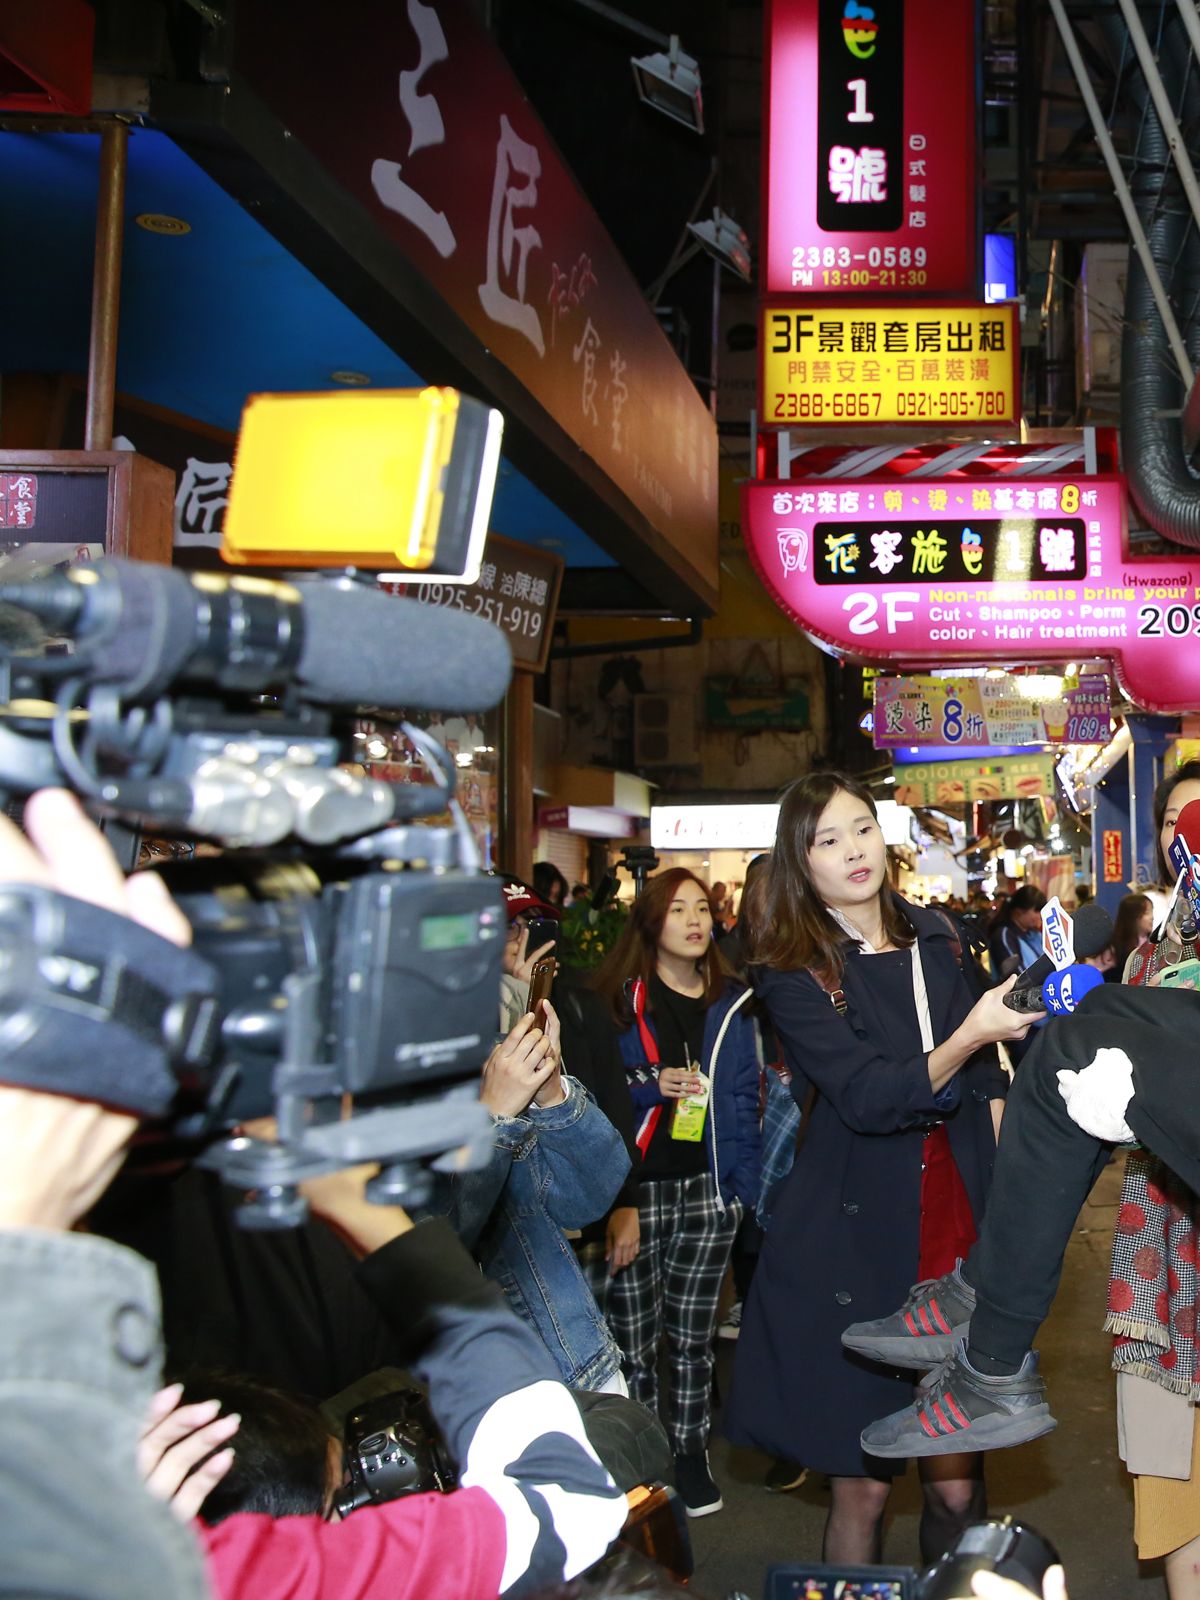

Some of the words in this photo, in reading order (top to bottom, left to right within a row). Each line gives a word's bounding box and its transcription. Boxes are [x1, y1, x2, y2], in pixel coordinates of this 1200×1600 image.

[792, 246, 928, 268] 2383-0589
[792, 270, 814, 287] PM
[822, 270, 928, 287] 13:00-21:30
[771, 314, 1006, 354] 3F景觀套房出租
[1121, 572, 1194, 587] (Hwazong)
[1083, 585, 1136, 601] bring
[1144, 586, 1188, 602] your
[842, 591, 922, 636] 2F
[978, 605, 1063, 623] Shampoo
[929, 625, 976, 640] color
[994, 624, 1034, 639] Hair
[1039, 622, 1128, 639] treatment
[1045, 906, 1068, 963] TVBS
[1046, 983, 1063, 1012] 中天
